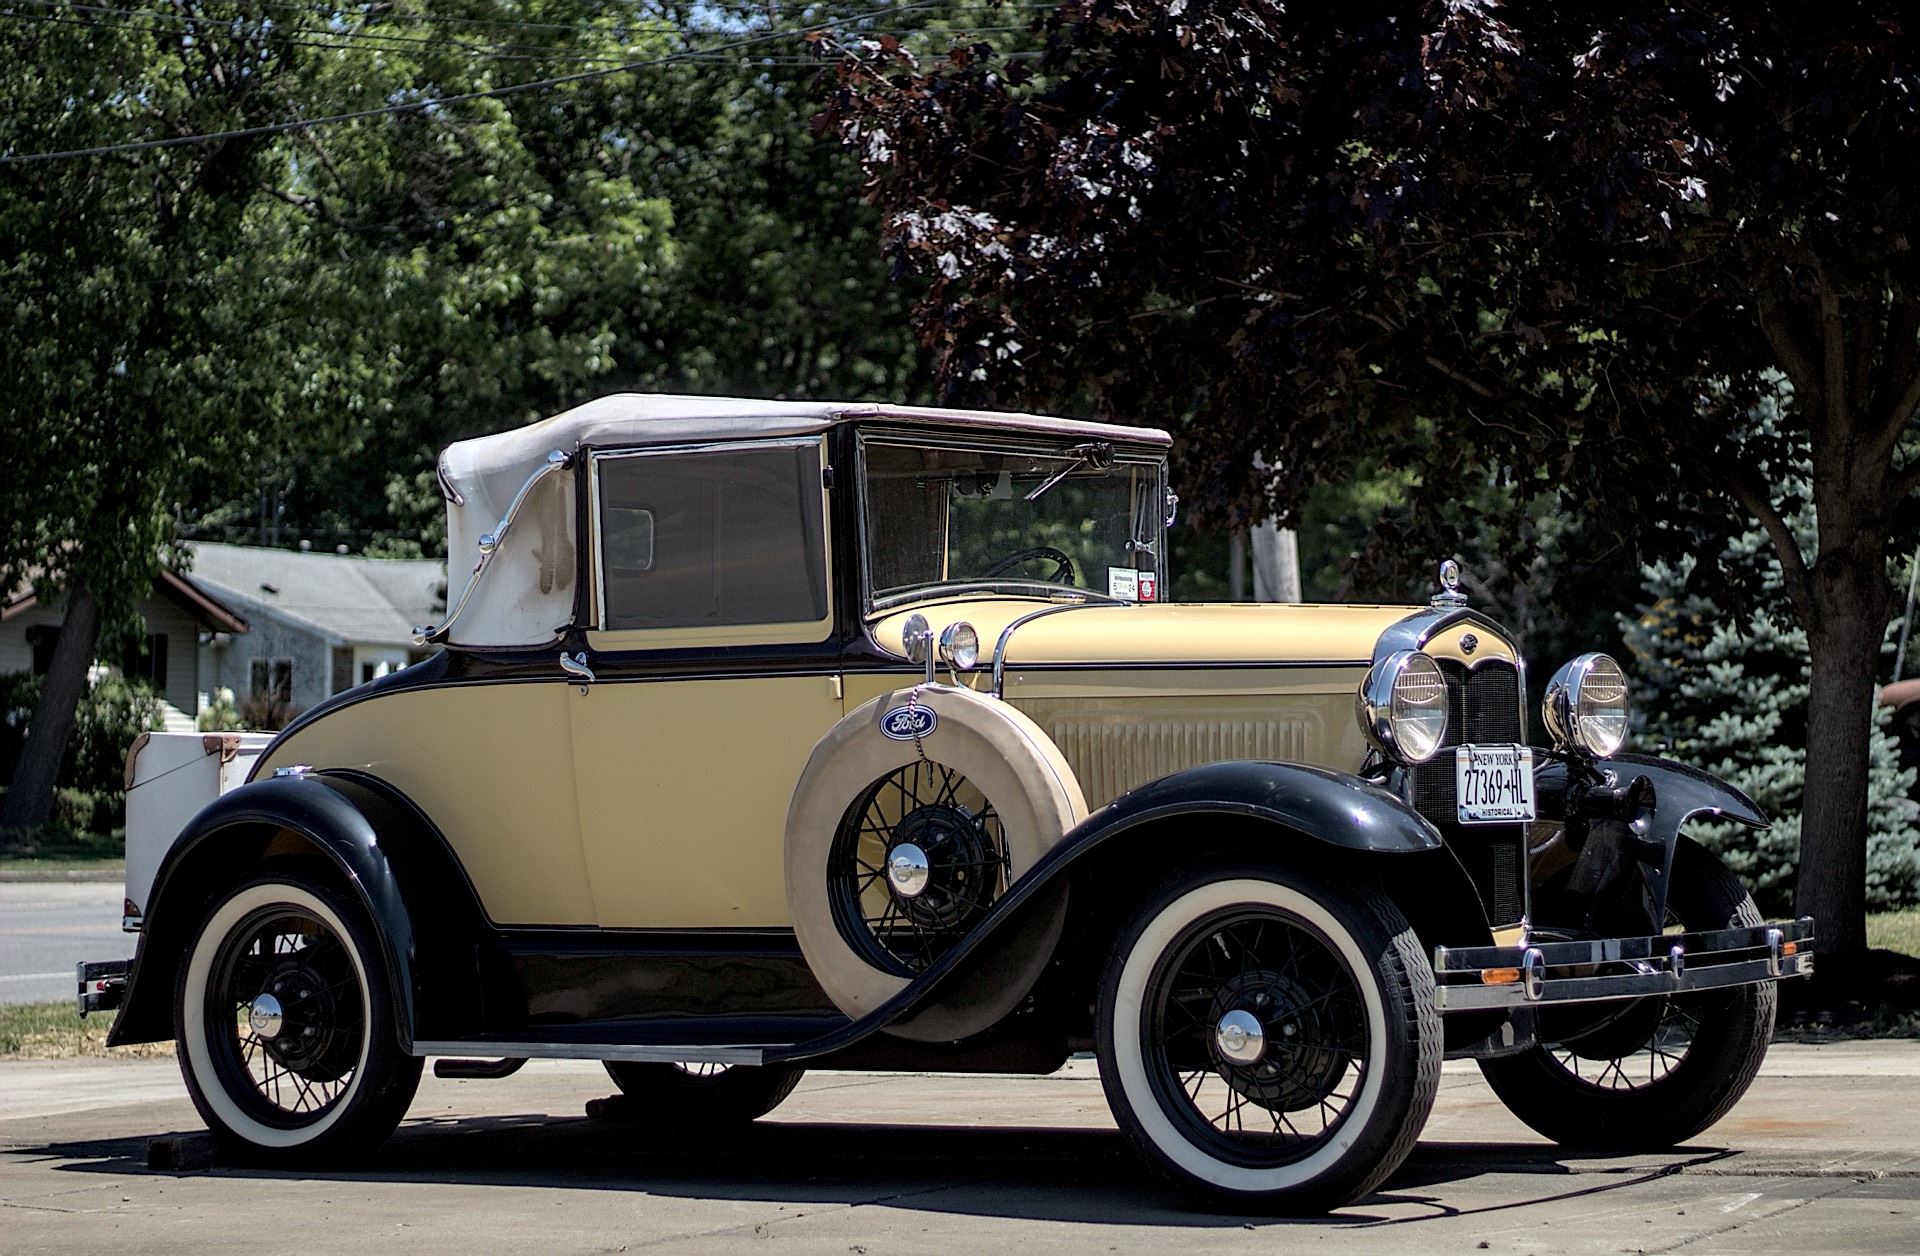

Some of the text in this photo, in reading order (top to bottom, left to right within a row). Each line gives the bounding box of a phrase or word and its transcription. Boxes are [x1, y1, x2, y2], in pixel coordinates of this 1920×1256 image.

[891, 713, 926, 732] Ford
[1477, 754, 1514, 766] NEW YORK
[1481, 808, 1513, 817] HISTORICAL
